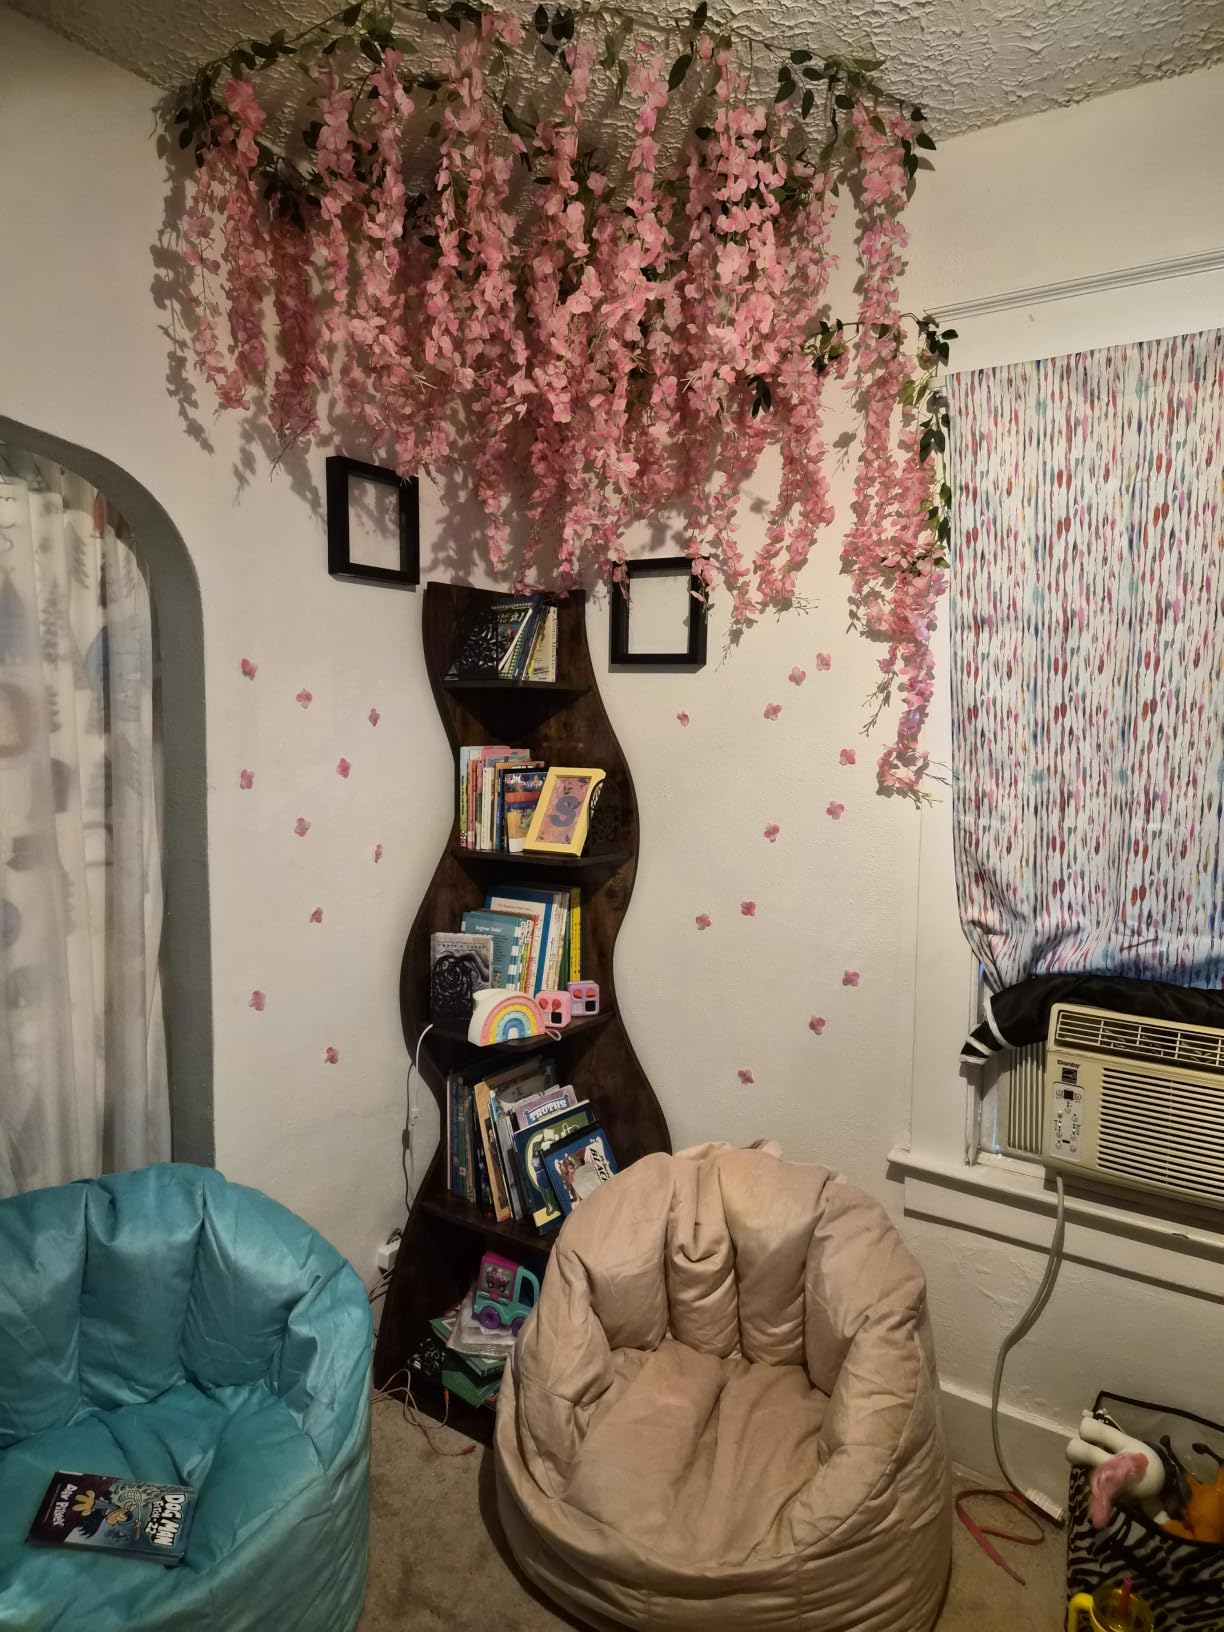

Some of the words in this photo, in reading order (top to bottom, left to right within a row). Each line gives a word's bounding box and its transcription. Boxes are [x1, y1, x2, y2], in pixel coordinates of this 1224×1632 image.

[529, 1099, 567, 1121] TRUTHS
[163, 1494, 186, 1518] DOG
[153, 1519, 180, 1546] MAN
